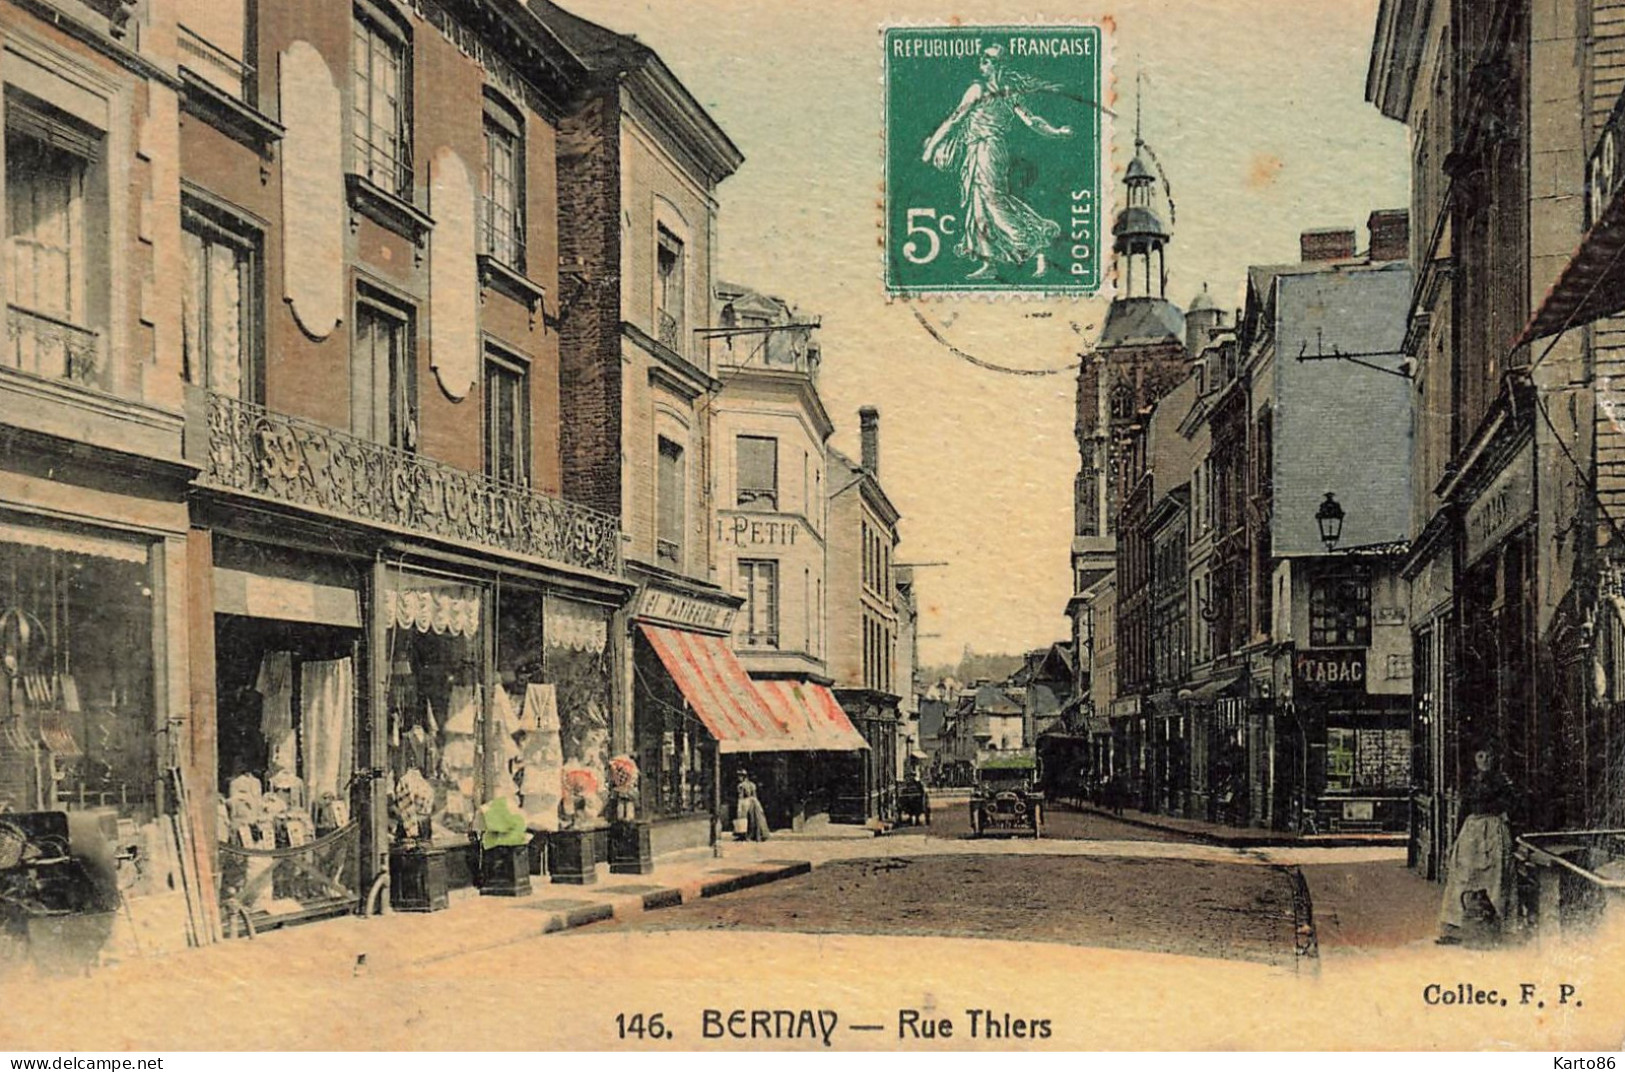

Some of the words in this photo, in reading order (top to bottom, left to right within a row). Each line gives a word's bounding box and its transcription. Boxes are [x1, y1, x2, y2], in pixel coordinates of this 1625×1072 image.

[893, 38, 982, 58] REPUBLIQUE
[1009, 37, 1091, 58] FRANÇAISE
[1072, 189, 1091, 275] POSTES
[1305, 659, 1362, 681] TABAC
